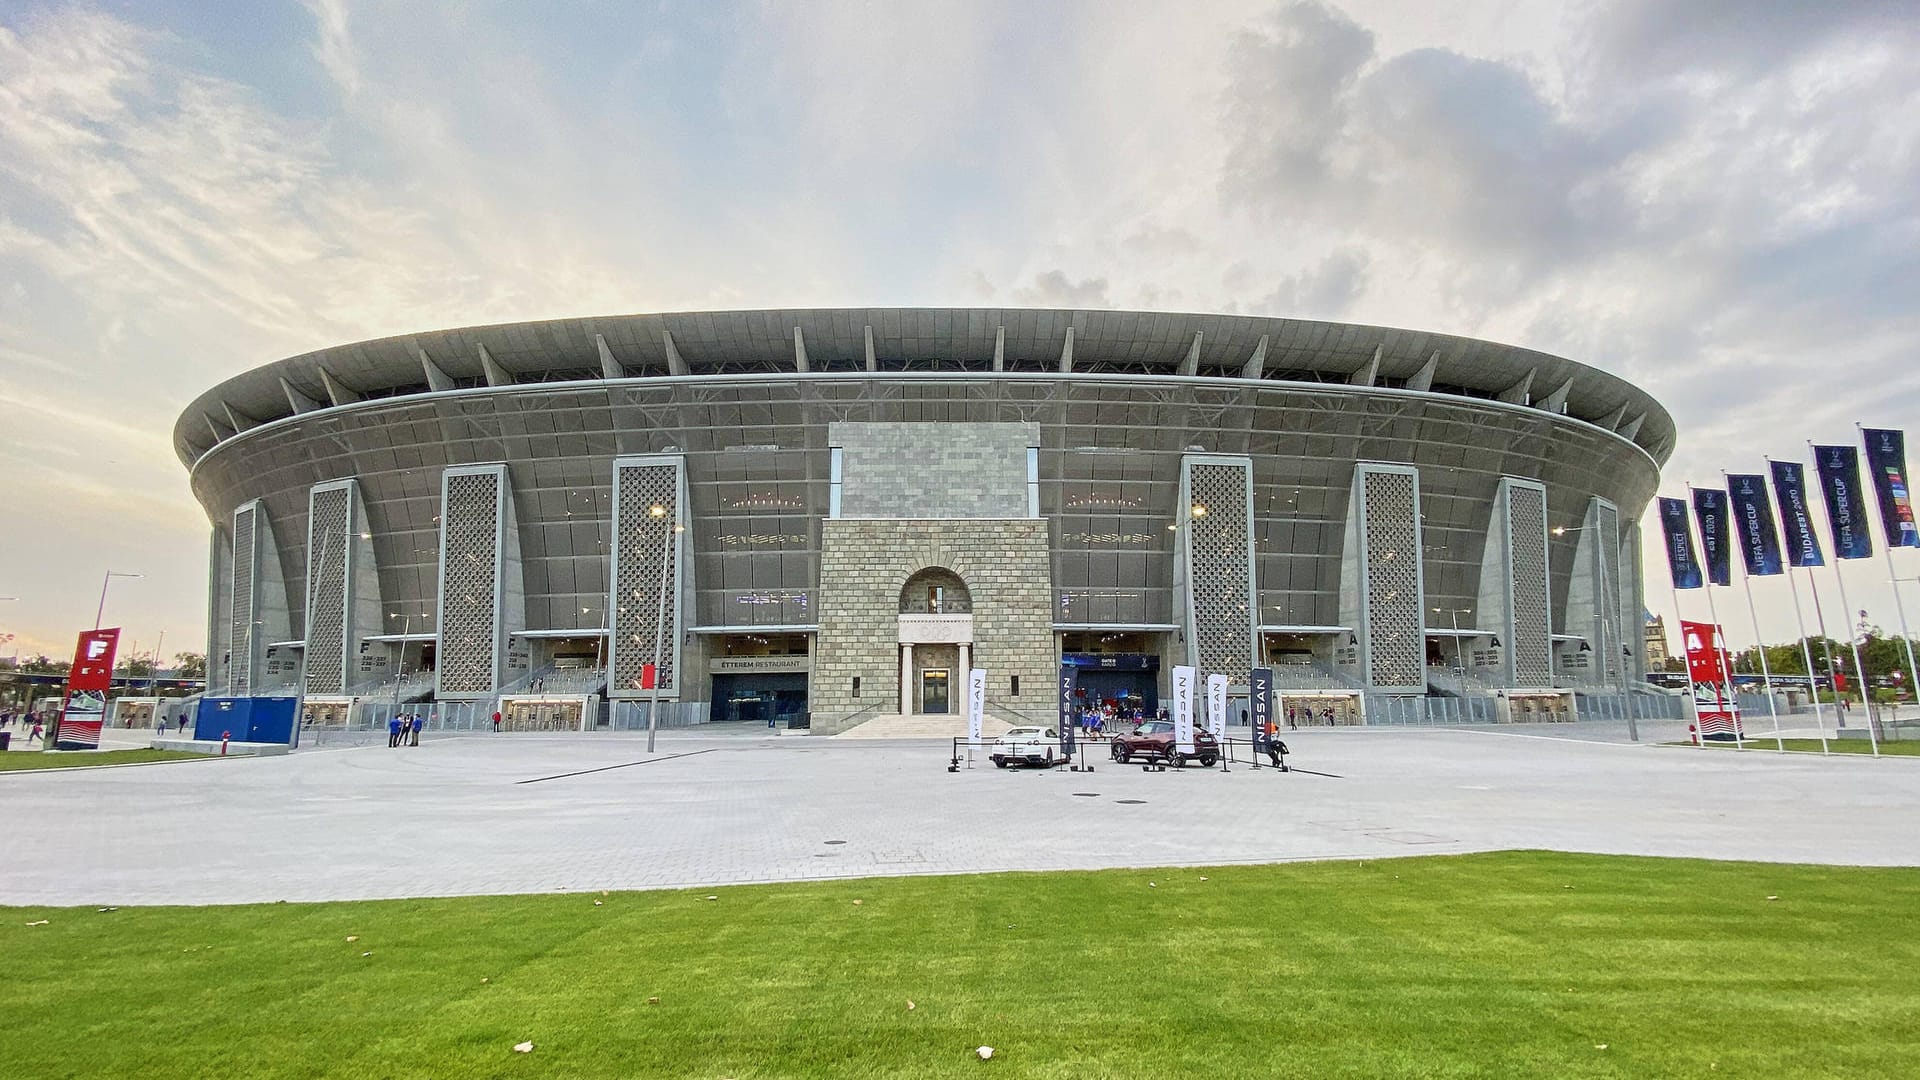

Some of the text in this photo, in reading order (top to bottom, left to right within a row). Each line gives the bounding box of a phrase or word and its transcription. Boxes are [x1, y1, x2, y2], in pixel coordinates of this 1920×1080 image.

[1705, 514, 1715, 534] 2020
[1795, 511, 1815, 559] BUDAPEST
[1753, 545, 1765, 567] UEFA
[508, 637, 516, 649] F
[1350, 634, 1358, 645] A
[1490, 637, 1502, 648] A
[1579, 641, 1592, 651] A
[1688, 633, 1703, 649] A
[87, 640, 108, 658] F
[266, 648, 278, 659] F
[360, 642, 370, 653] F
[721, 660, 801, 669] ÉTTEREM RESTAURANT
[1063, 677, 1071, 743] NISSAN
[1257, 679, 1266, 742] NISSAN
